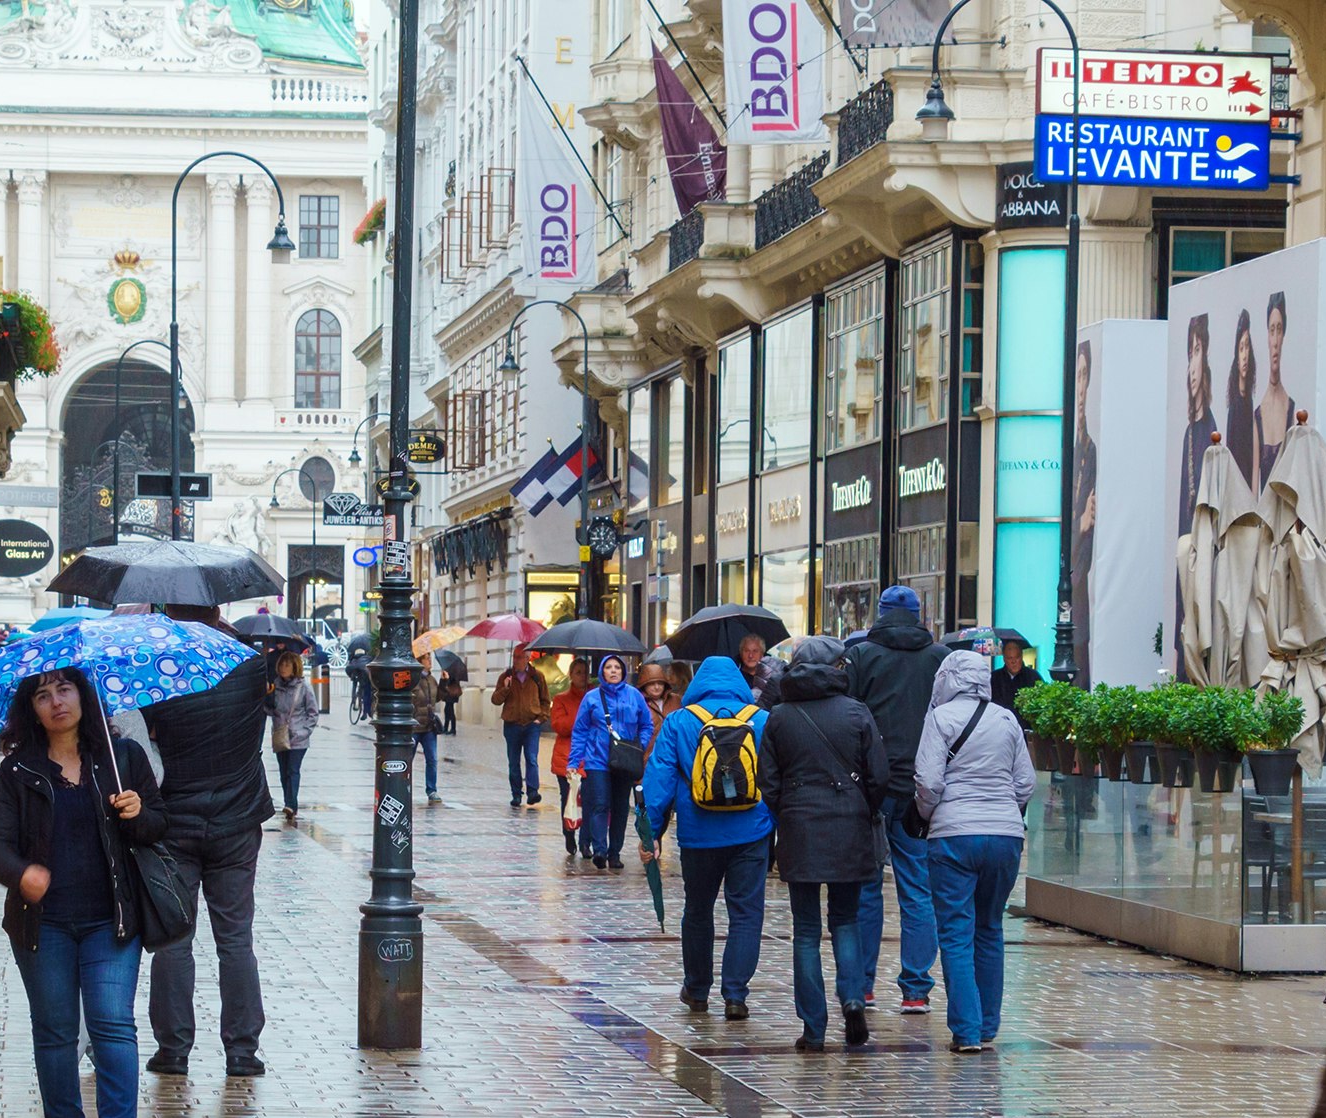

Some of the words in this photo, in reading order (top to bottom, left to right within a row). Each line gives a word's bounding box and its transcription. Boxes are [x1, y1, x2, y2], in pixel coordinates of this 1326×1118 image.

[748, 2, 789, 118] BDO
[1085, 61, 1219, 85] TEMPO
[1047, 122, 1210, 148] RESTAURANT
[1047, 147, 1210, 182] LEVANTE
[1004, 173, 1045, 190] DOLC
[540, 183, 570, 268] BDO
[408, 442, 437, 451] DEMEL
[0, 539, 49, 548] International
[5, 549, 30, 559] Glass
[31, 550, 45, 559] Art
